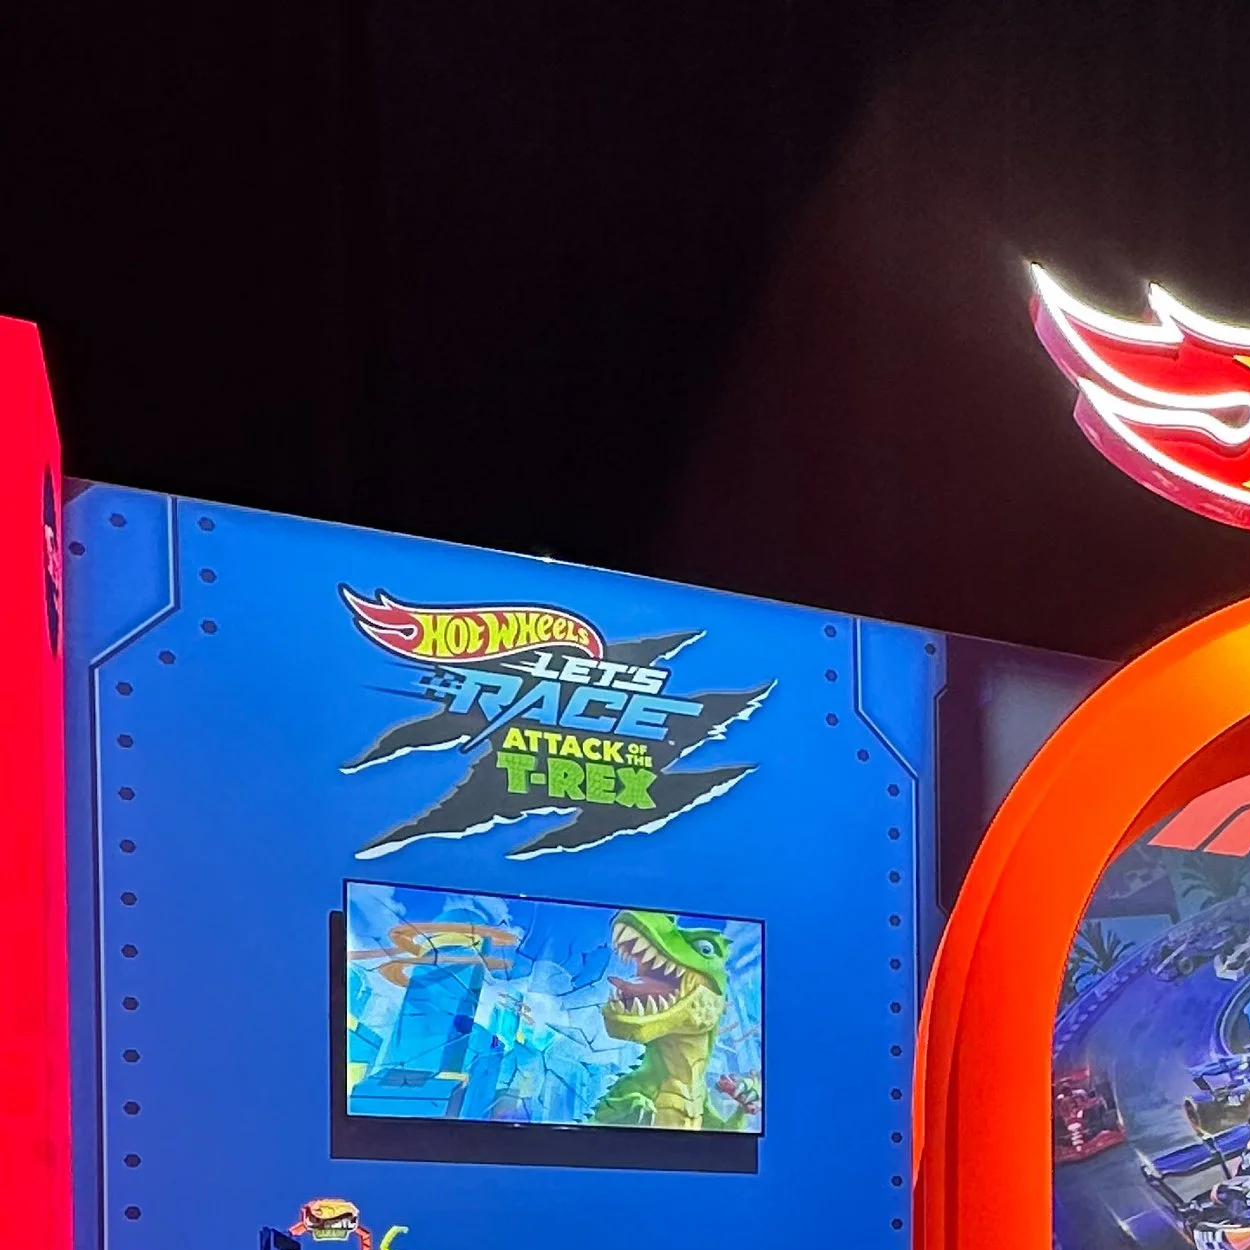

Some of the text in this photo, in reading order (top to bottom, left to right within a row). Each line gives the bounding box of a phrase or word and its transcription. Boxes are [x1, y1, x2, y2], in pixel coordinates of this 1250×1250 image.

[525, 650, 669, 695] LET'S
[440, 665, 704, 751] RACE
[502, 727, 653, 768] ATTACK OF THE
[496, 751, 657, 810] T-REX
